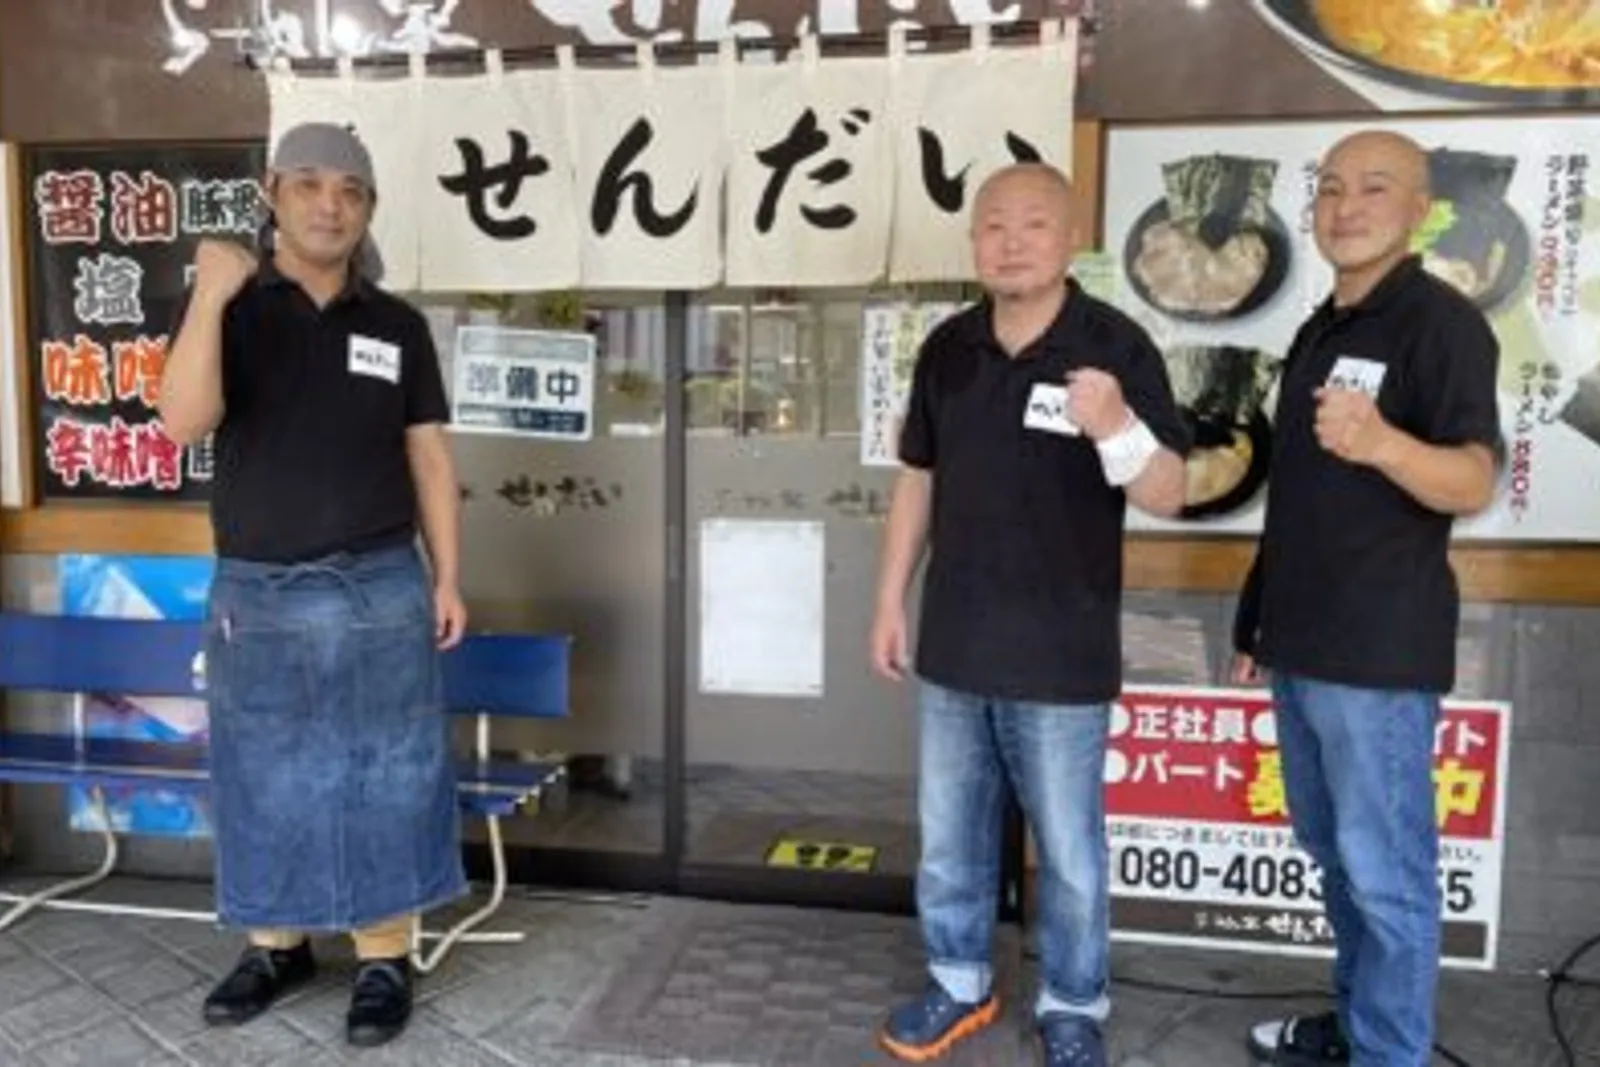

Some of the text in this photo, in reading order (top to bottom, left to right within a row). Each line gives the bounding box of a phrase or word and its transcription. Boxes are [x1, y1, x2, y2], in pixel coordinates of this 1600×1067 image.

[35, 170, 177, 243] 醤油
[437, 107, 1042, 241] せんだい
[74, 253, 144, 323] 塩
[1132, 704, 1248, 744] 正社員
